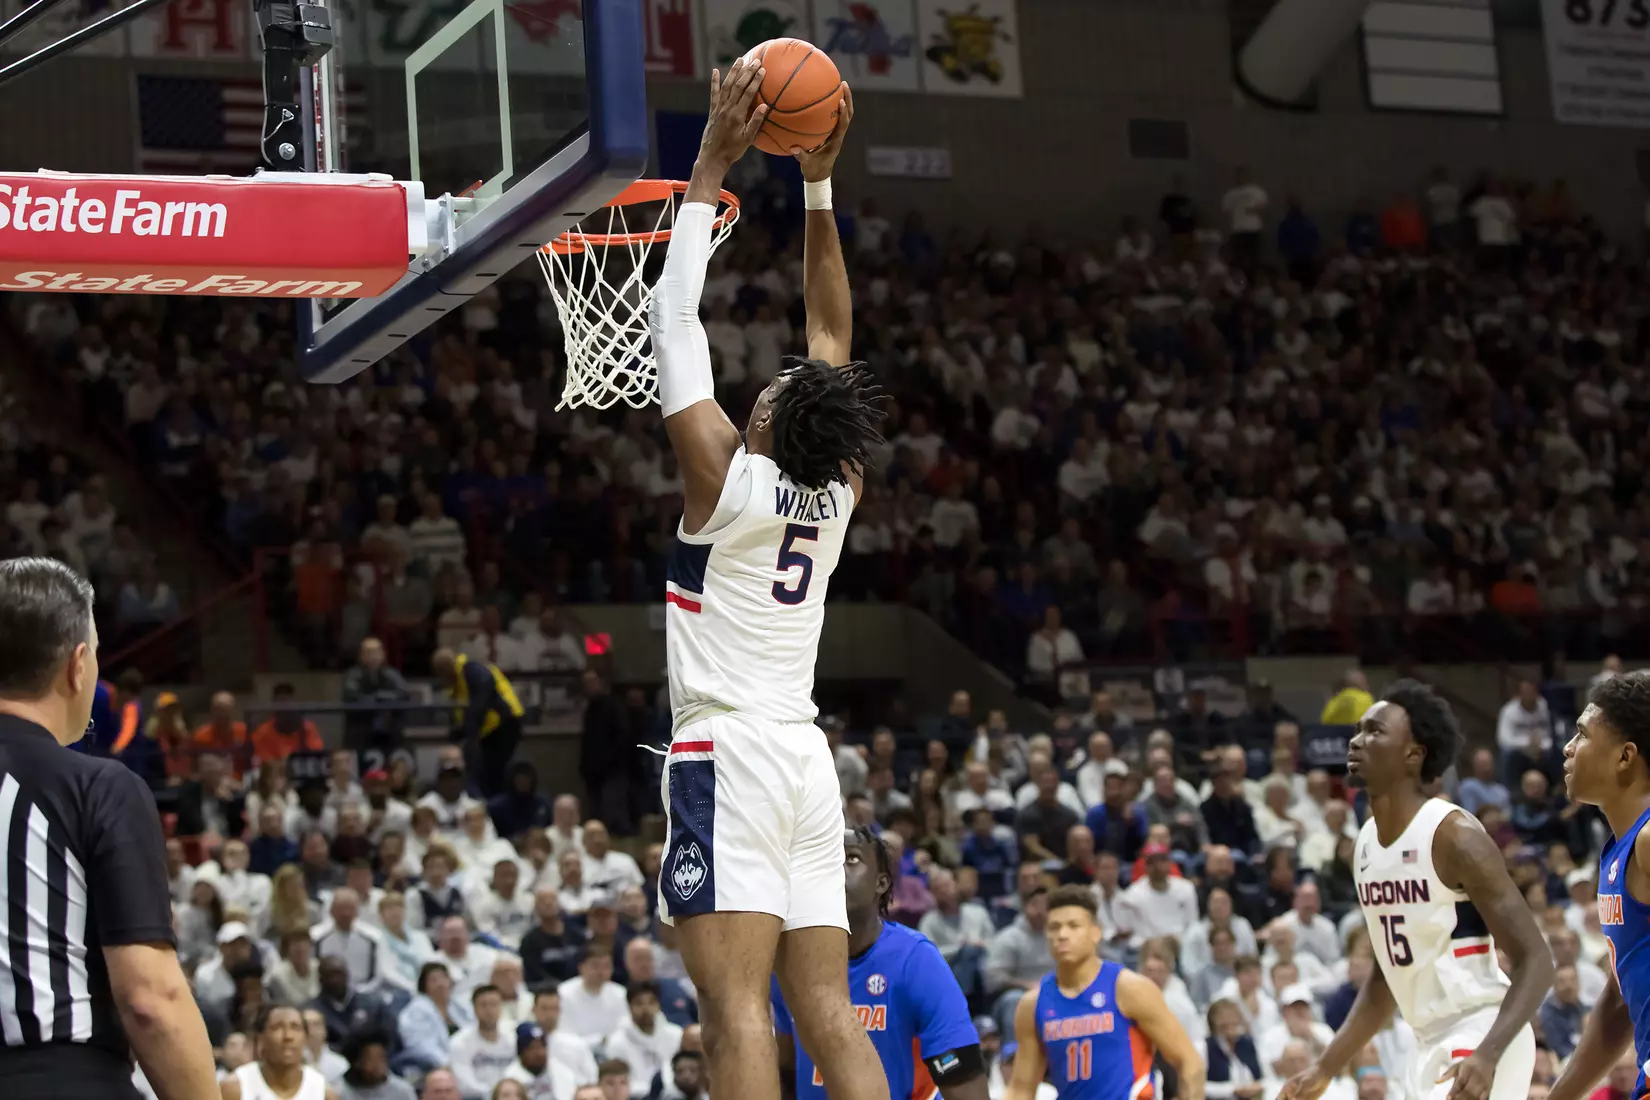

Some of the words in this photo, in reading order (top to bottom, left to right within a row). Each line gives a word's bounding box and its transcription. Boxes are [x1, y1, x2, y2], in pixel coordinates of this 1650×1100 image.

[0, 184, 106, 233] State
[110, 189, 228, 237] Farm
[2, 271, 188, 292] State
[185, 275, 363, 295] Farm
[771, 523, 819, 605] 5
[1358, 879, 1431, 906] UCONN
[1379, 915, 1414, 967] 15
[868, 976, 886, 994] SEC
[1043, 1011, 1115, 1042] FLORIDA
[1066, 1037, 1093, 1082] 11
